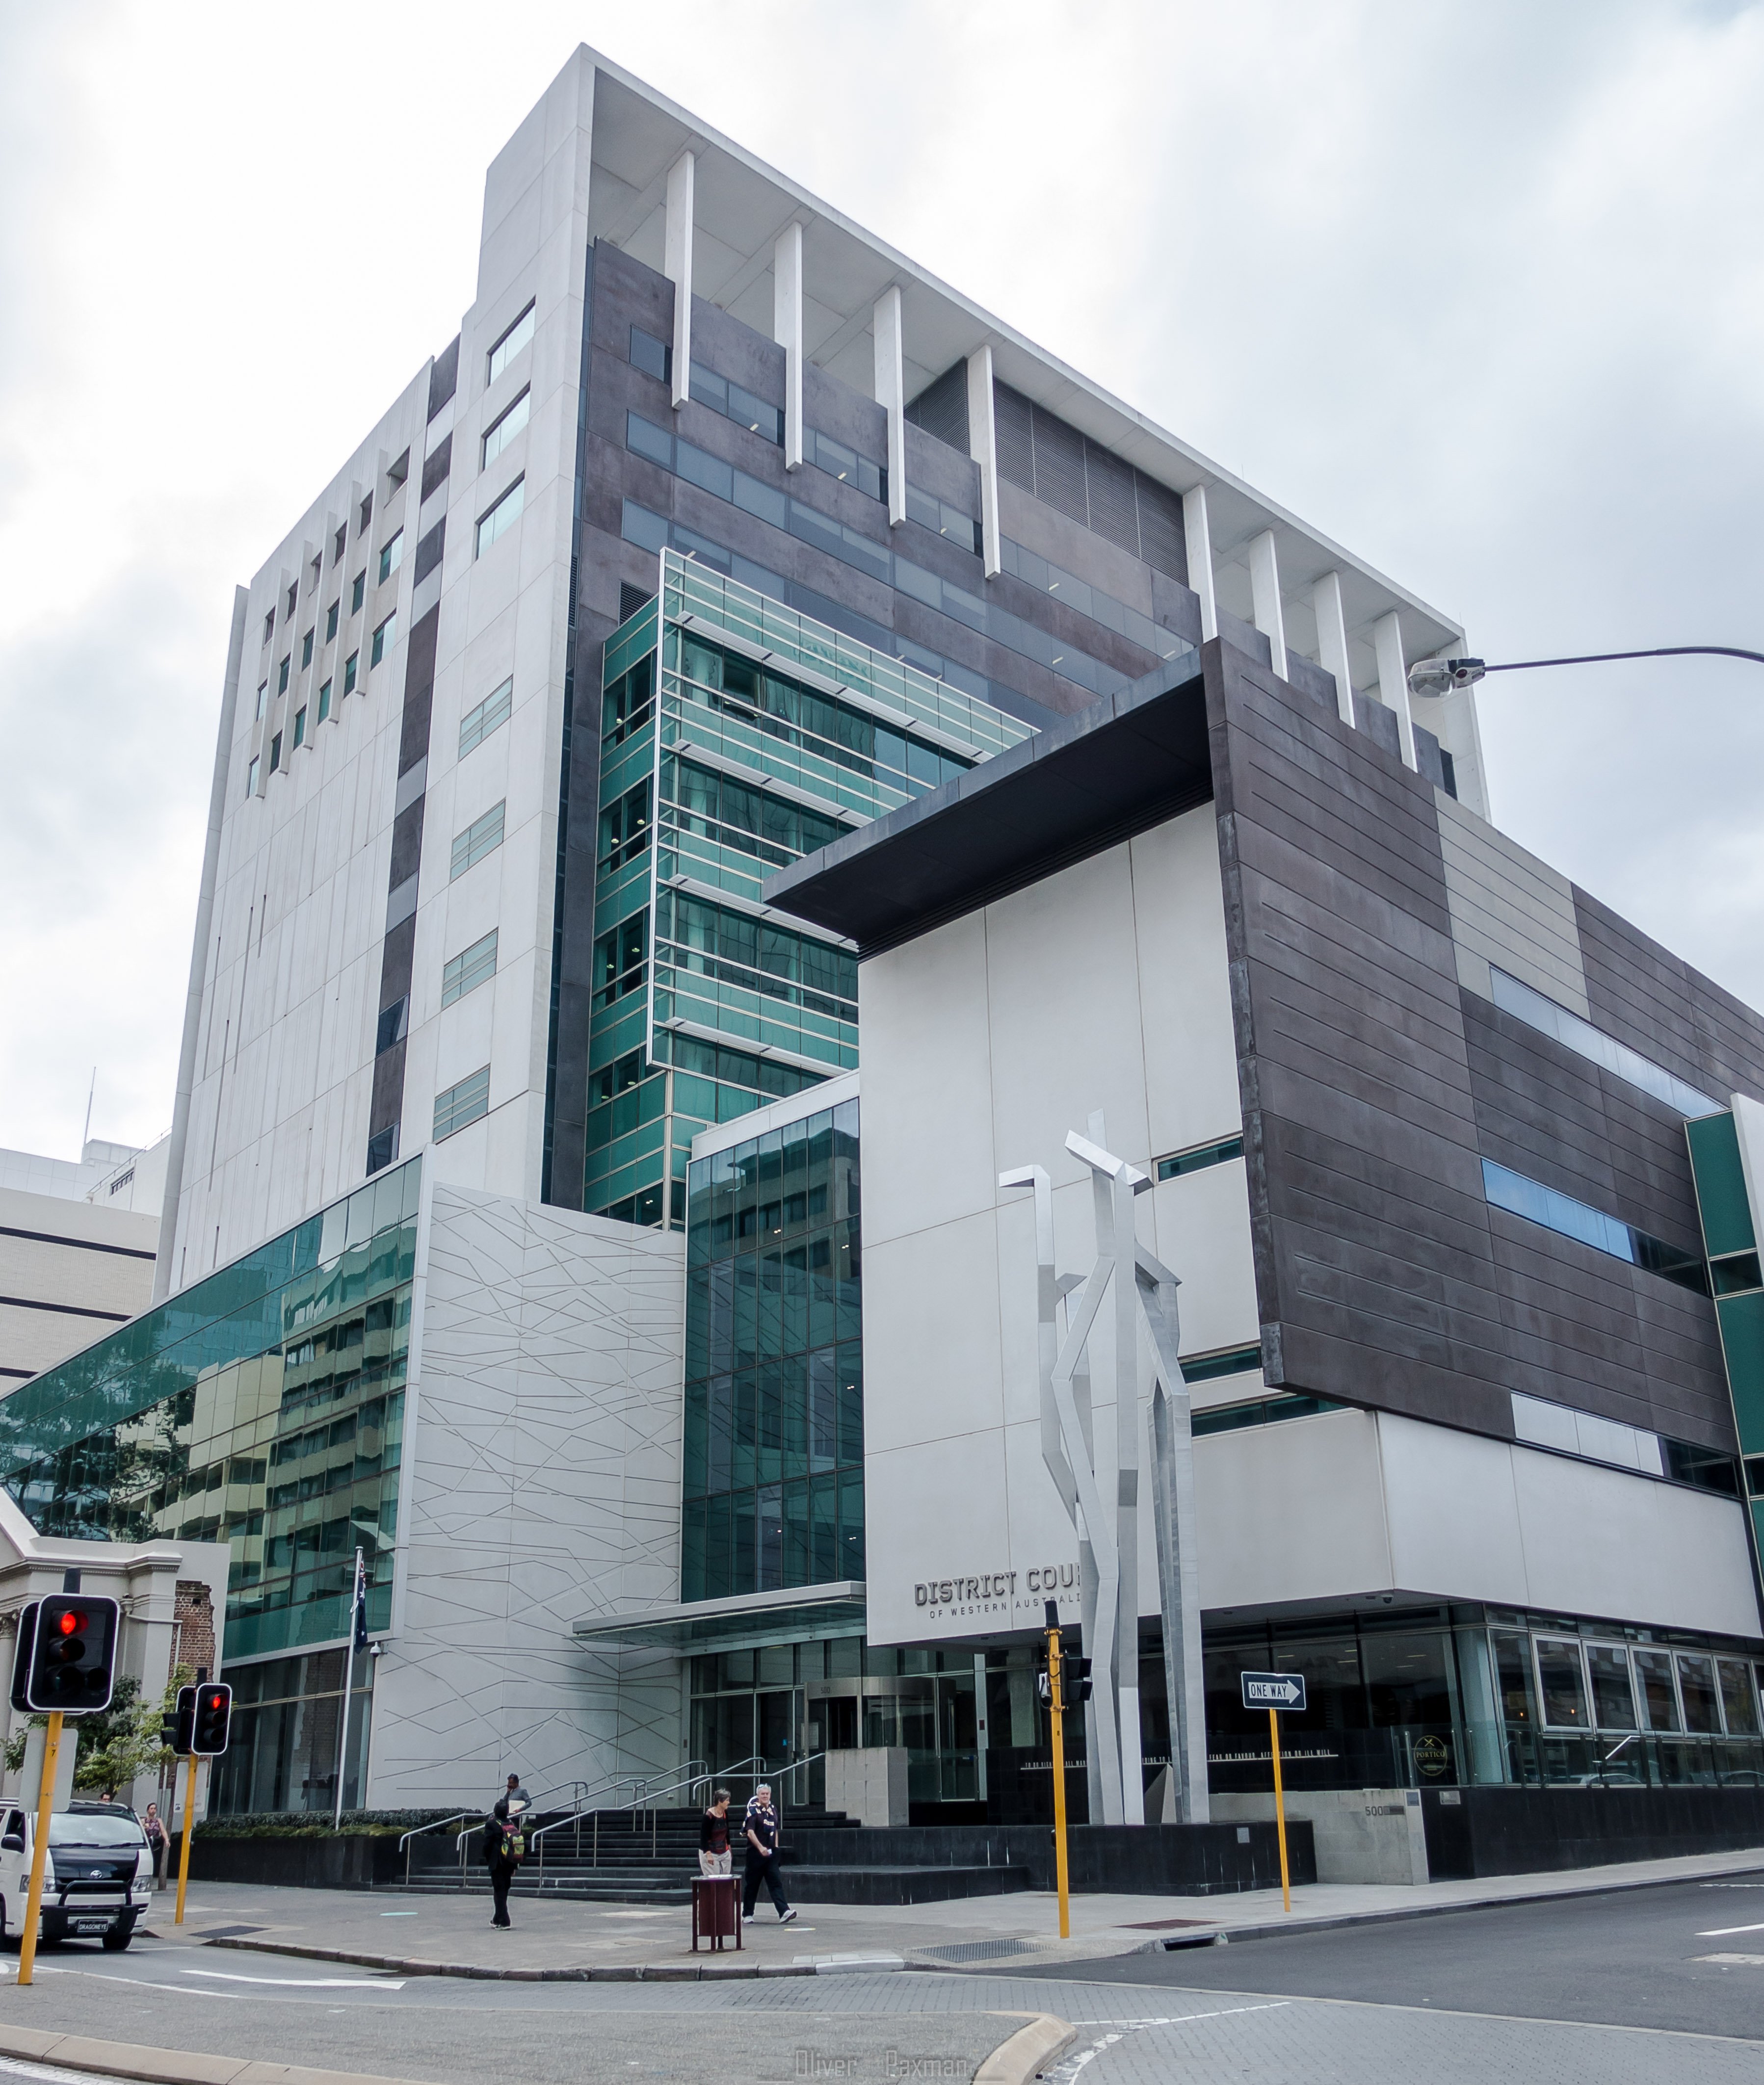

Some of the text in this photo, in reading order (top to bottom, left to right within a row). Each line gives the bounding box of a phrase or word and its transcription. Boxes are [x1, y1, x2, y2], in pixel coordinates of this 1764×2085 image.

[915, 1562, 1079, 1606] DISTRICT COU
[930, 1593, 1080, 1618] OF WESTERN AUSTRALI
[1251, 1684, 1286, 1697] ONE WAY
[1365, 1806, 1383, 1816] 500
